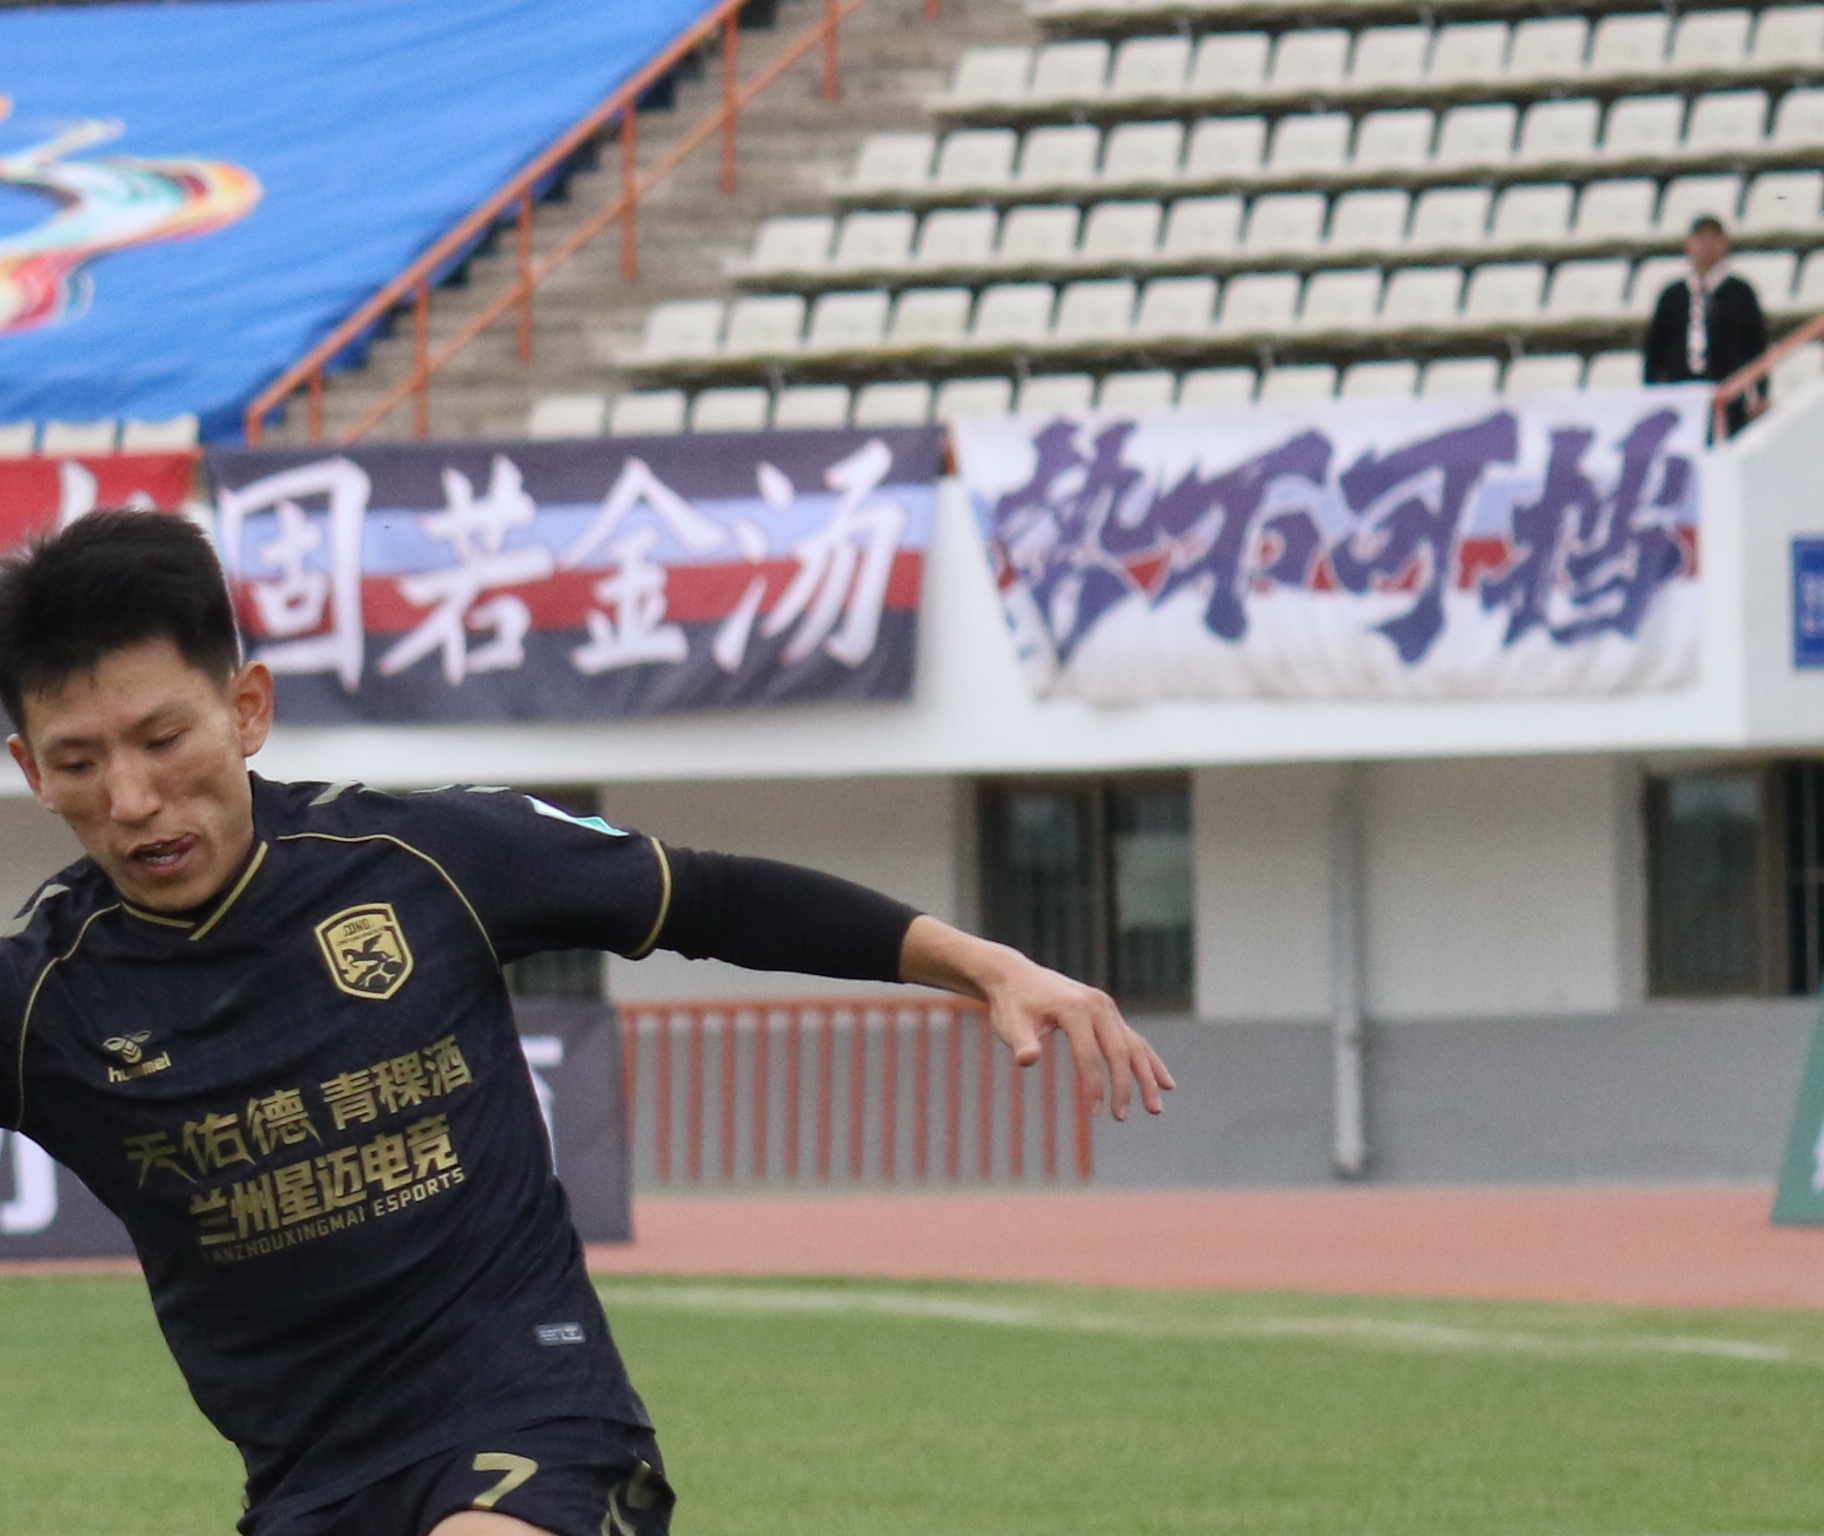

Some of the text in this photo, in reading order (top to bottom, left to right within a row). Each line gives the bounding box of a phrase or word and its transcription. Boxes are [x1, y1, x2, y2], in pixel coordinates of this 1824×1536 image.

[219, 440, 904, 690] 固若金汤
[122, 1088, 323, 1190] 天佑德
[320, 1034, 473, 1131] 青稞酒
[189, 1113, 459, 1246] 兰州星迈电竞
[374, 1167, 467, 1217] ESPORTS
[472, 1452, 539, 1510] 7
